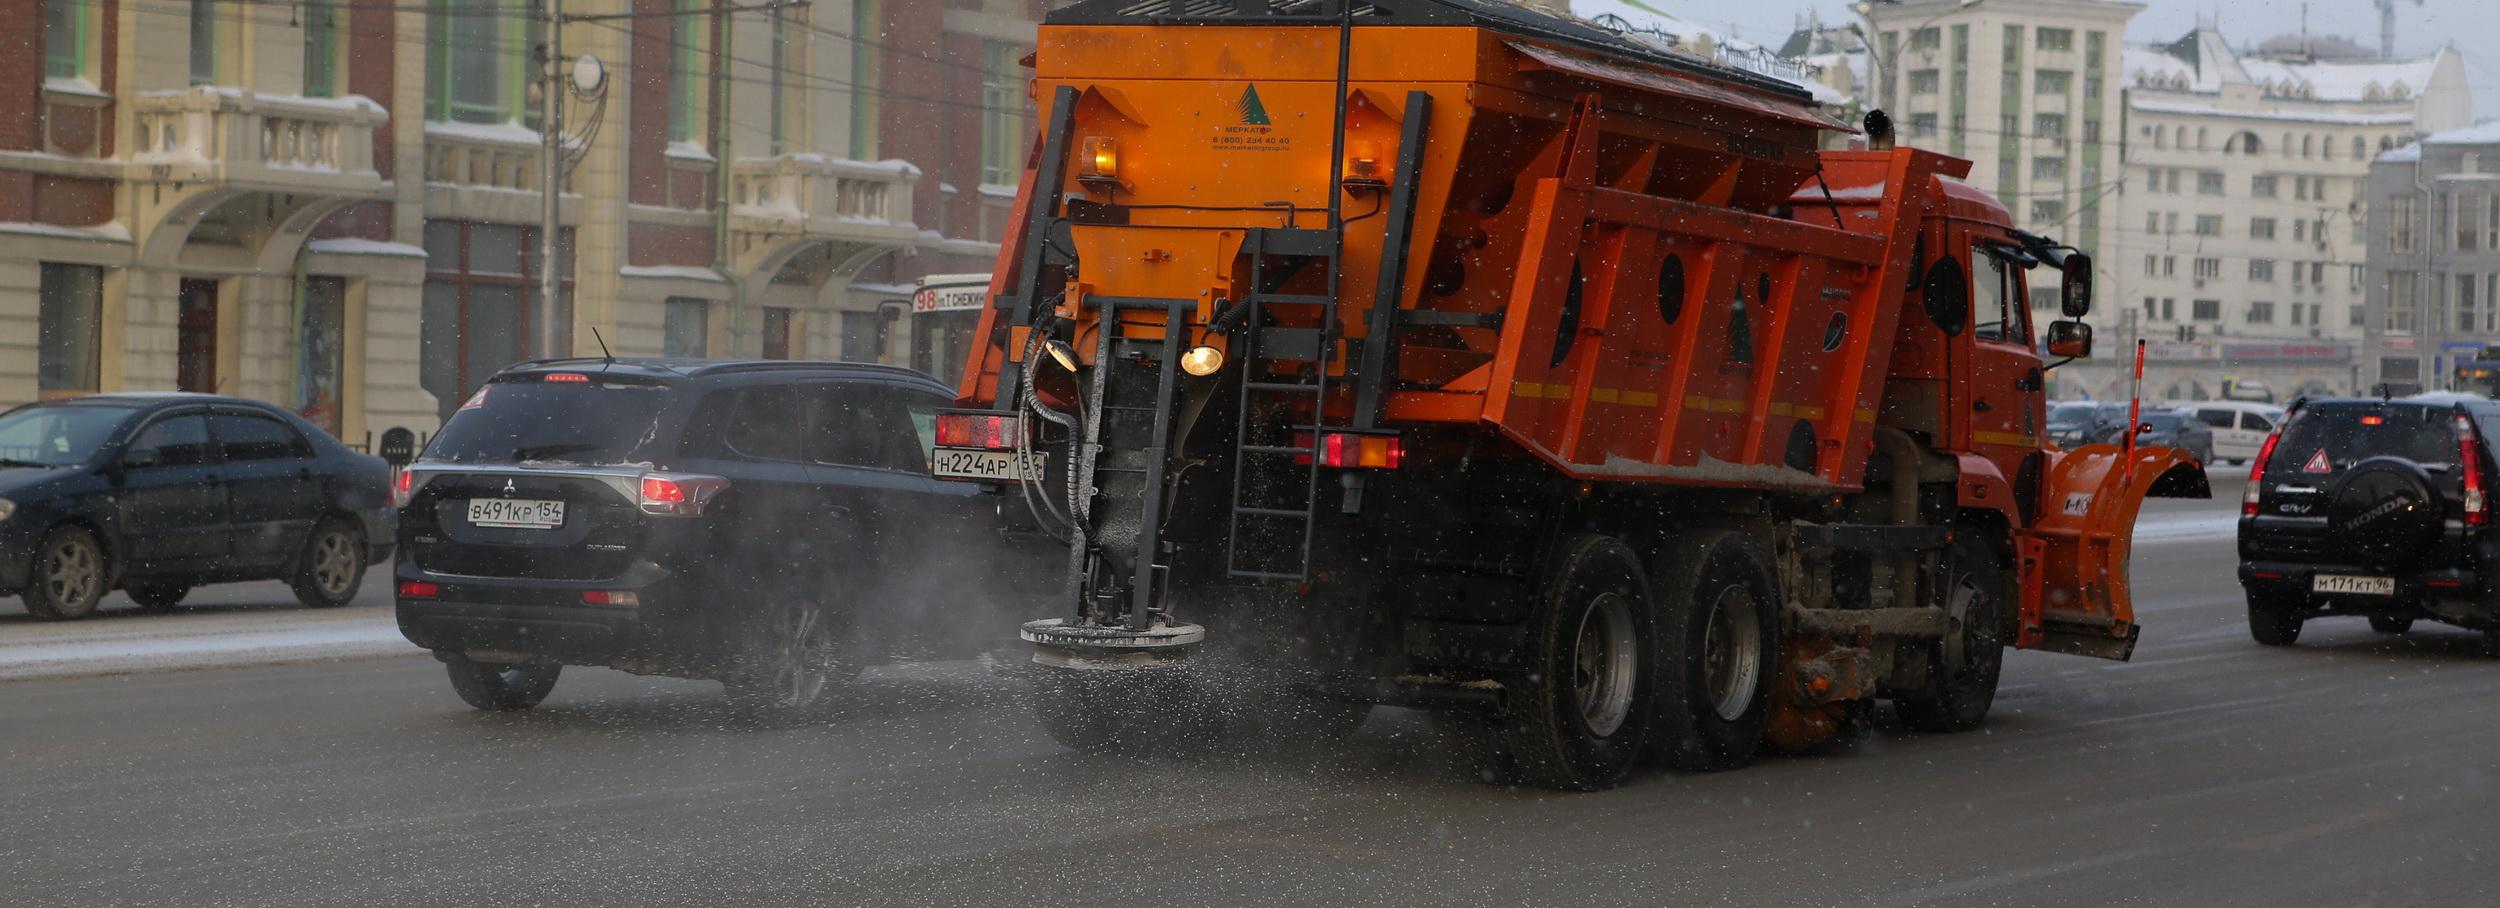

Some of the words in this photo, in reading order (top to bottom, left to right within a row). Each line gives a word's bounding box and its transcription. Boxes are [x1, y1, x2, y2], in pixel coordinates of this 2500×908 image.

[1225, 126, 1272, 134] МЕРКАТОР
[1221, 136, 1243, 144] (800)
[917, 290, 936, 310] 98
[940, 453, 1008, 475] Н224АР
[473, 501, 532, 520] В491КР
[536, 502, 562, 518] 154
[2346, 495, 2410, 530] HONDA
[2318, 577, 2372, 591] М171КТ
